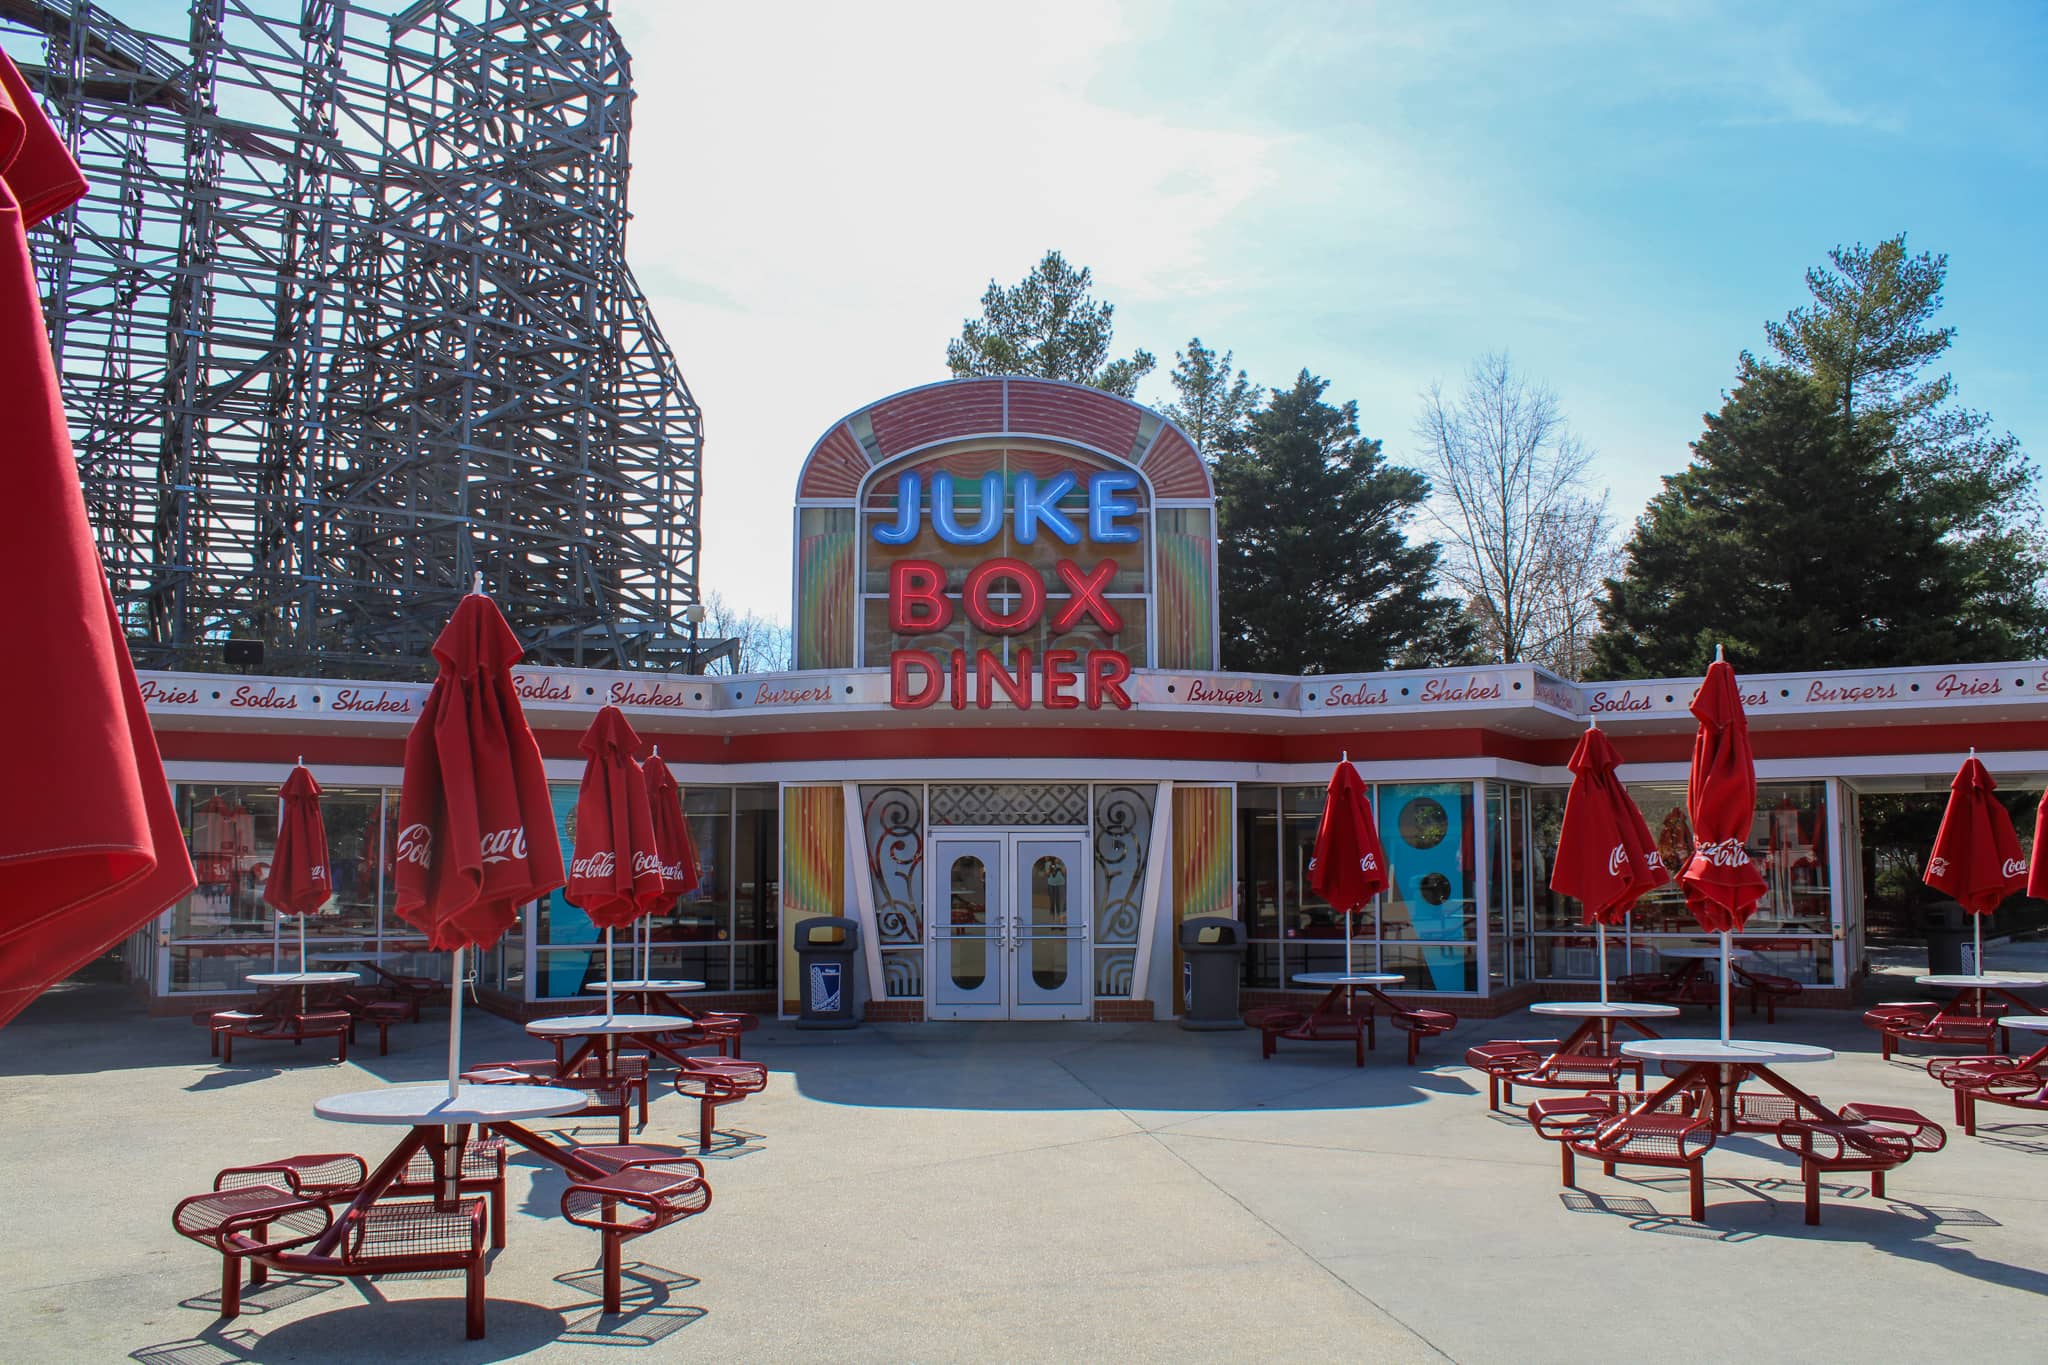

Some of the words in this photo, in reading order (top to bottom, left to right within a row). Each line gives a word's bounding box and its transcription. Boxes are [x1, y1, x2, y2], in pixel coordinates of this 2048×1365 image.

[871, 470, 1141, 545] JUKE
[889, 557, 1124, 636] BOX
[140, 681, 199, 704] Fries
[230, 686, 298, 708] Sodas
[331, 689, 411, 712] Shakes
[513, 676, 572, 700] Sodas
[609, 682, 684, 706] Shakes
[754, 682, 832, 705] Burgers
[890, 647, 1132, 711] DINER
[1187, 680, 1263, 703] Burgers
[1325, 684, 1389, 706] Sodas
[1420, 677, 1501, 701] Shakes
[1589, 690, 1652, 712] Sodas
[1806, 680, 1898, 702] Burgers
[1935, 674, 2003, 697] Fries
